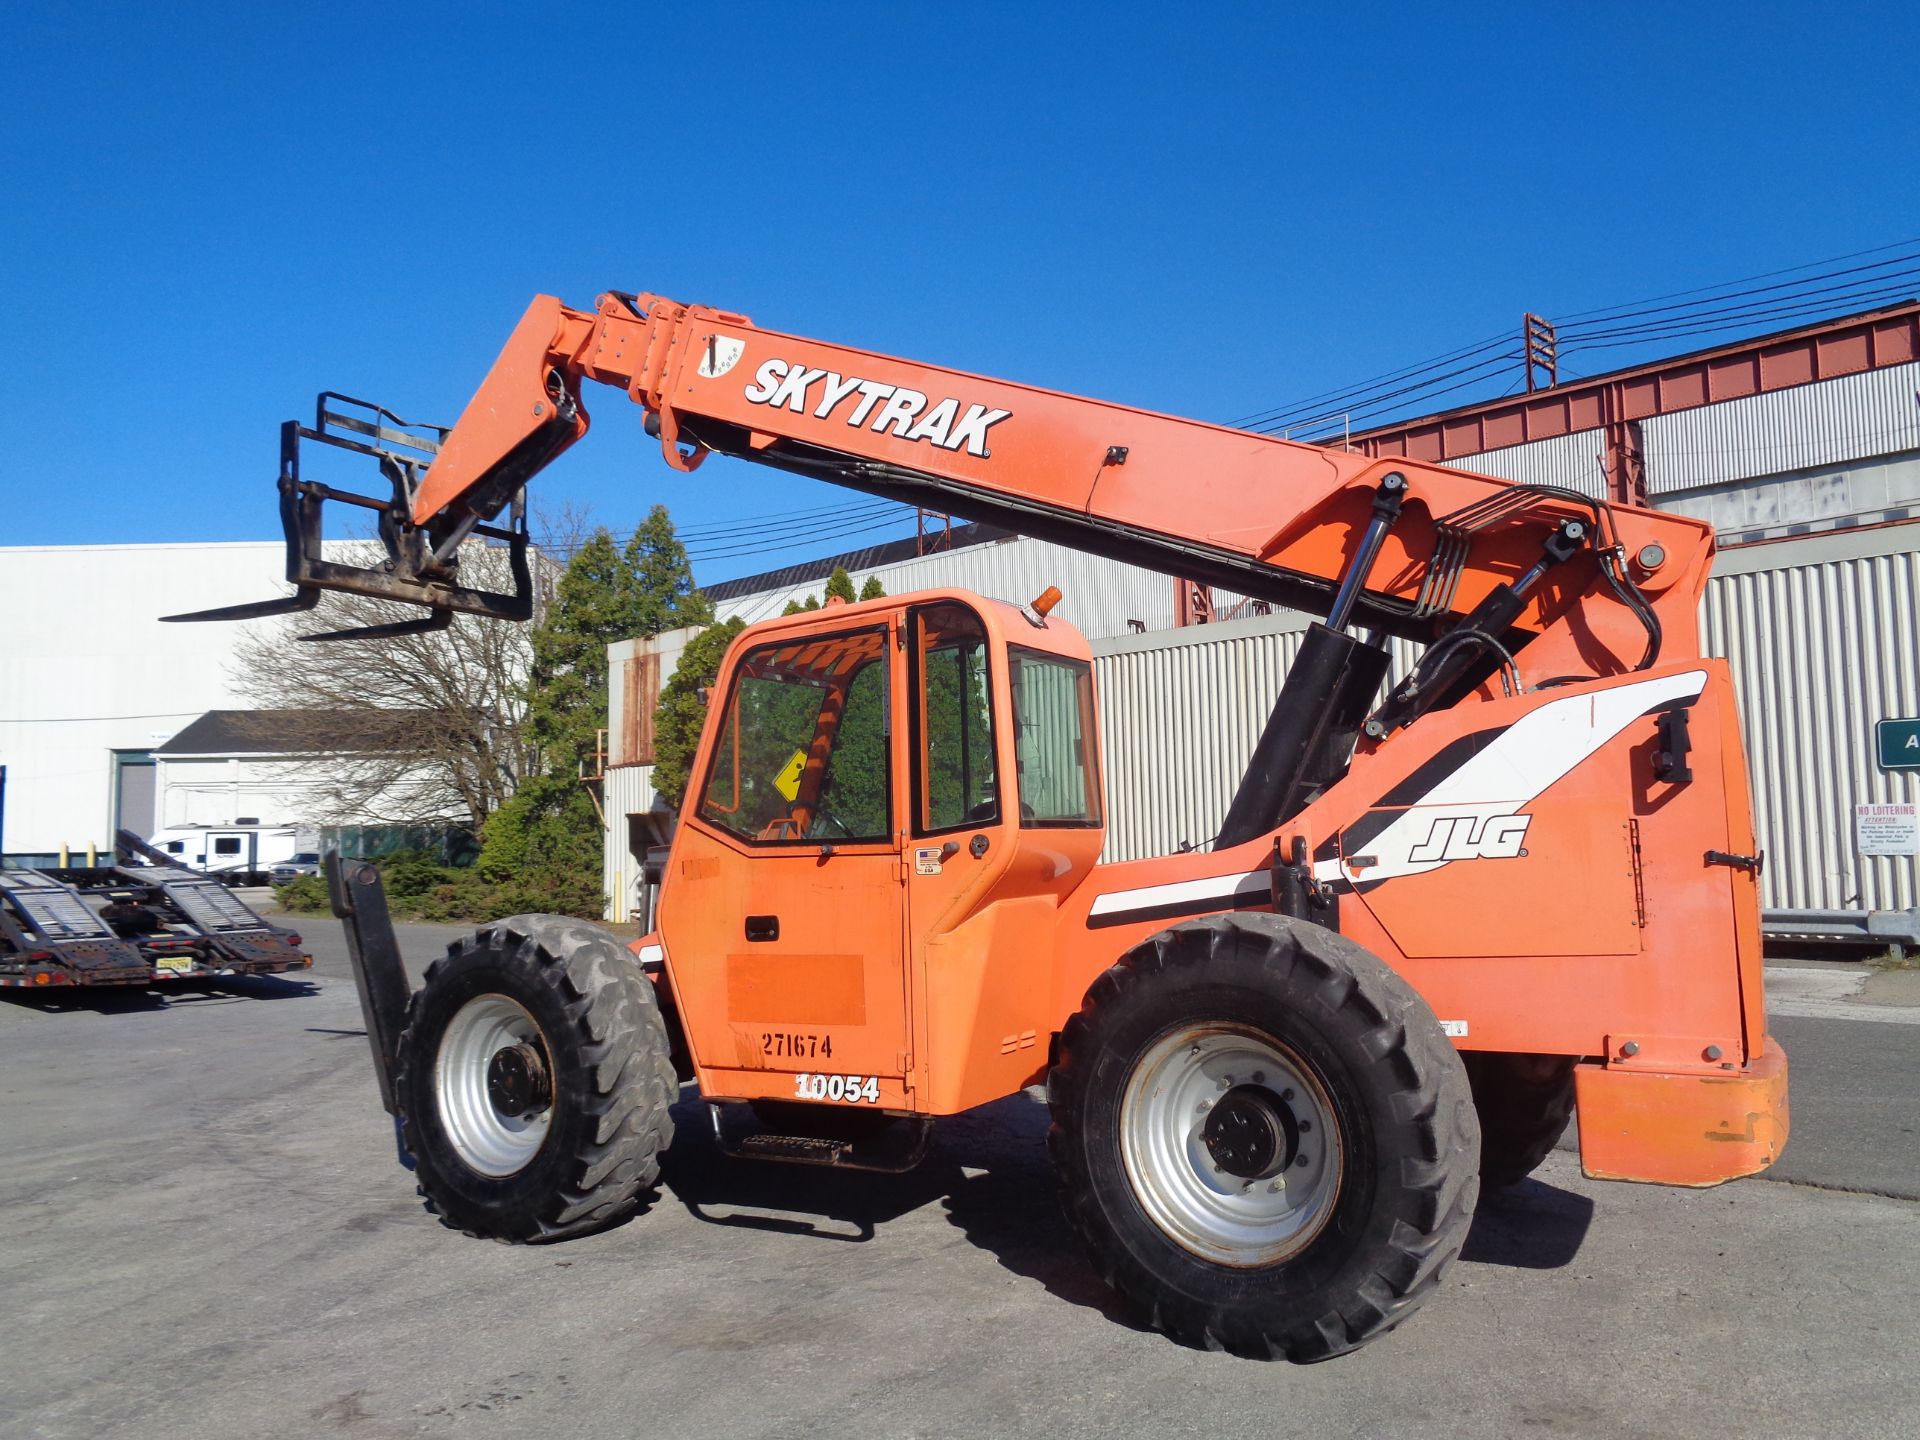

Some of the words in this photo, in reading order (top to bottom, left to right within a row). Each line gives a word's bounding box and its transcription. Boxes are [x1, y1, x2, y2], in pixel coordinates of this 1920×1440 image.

[744, 358, 1014, 459] SKYTRAK
[1904, 734, 1919, 749] A
[1858, 806, 1870, 816] NO
[1873, 805, 1915, 816] LOITERING
[1408, 814, 1533, 863] JLG
[762, 1033, 832, 1058] 271674
